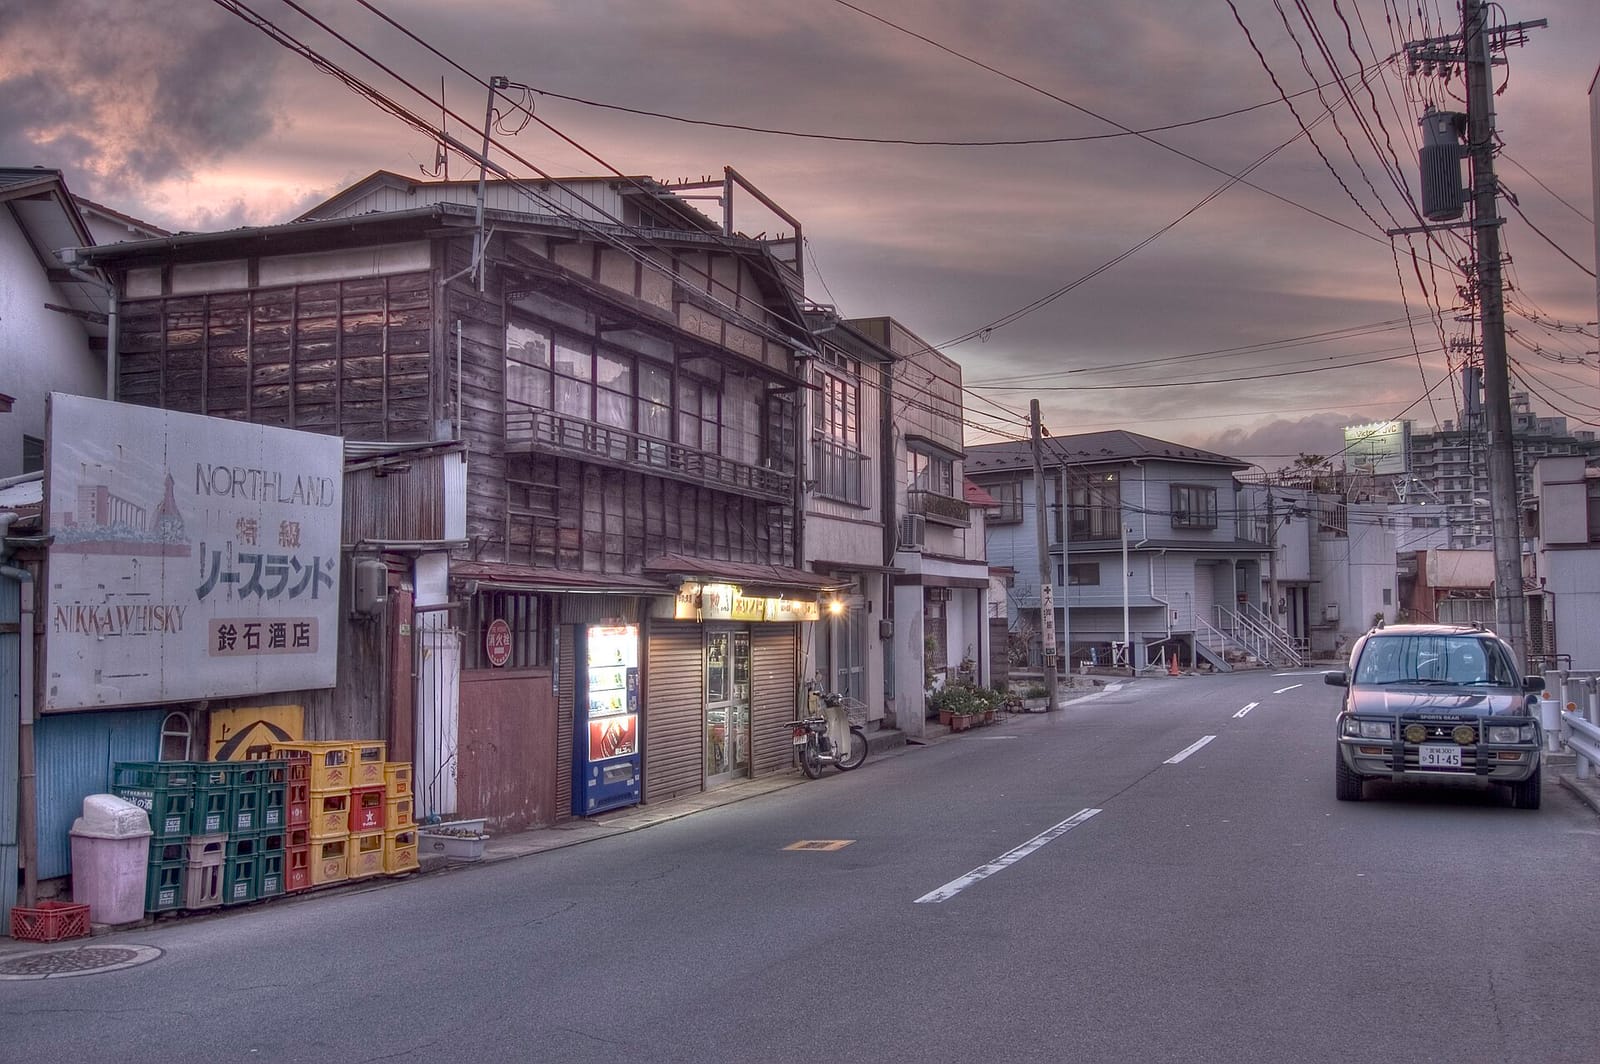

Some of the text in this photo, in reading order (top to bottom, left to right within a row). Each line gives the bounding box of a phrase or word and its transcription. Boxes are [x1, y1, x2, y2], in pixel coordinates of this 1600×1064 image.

[195, 462, 335, 508] NORTHLAND
[56, 604, 188, 636] NIKKA WHISKY
[217, 621, 311, 652] 鈴石酒店
[1428, 754, 1459, 765] 91-45
